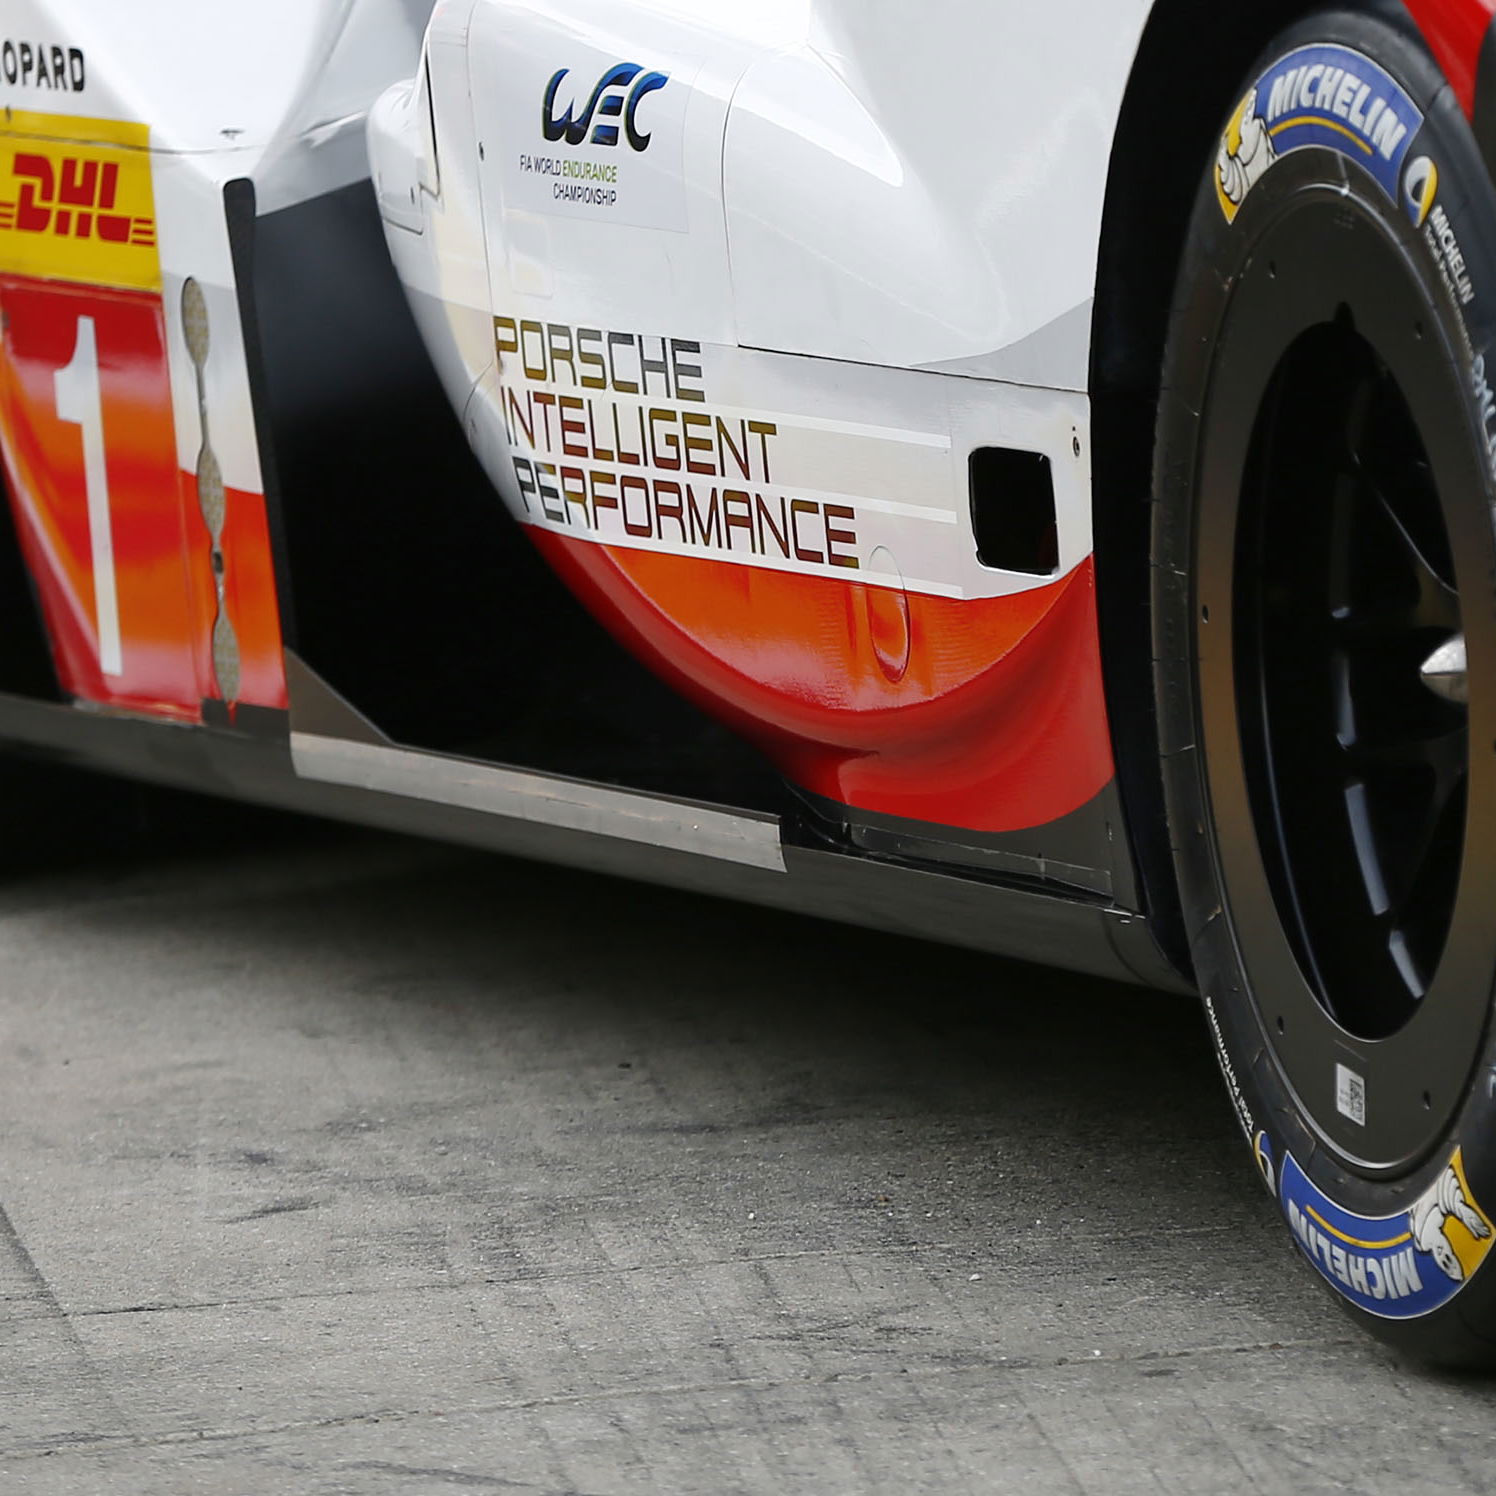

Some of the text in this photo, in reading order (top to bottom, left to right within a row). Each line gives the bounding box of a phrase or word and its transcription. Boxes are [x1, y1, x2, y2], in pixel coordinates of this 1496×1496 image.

[0, 40, 86, 93] OPARD
[542, 62, 671, 152] WEC
[1267, 63, 1407, 161] MICHELIN
[13, 152, 132, 244] DHL
[520, 154, 618, 184] FIA WORLD ENDURANCE
[553, 182, 617, 206] CHAMPIONSHIP
[1430, 204, 1475, 305] MICHELIN
[493, 315, 705, 403] PORSCHE
[500, 385, 777, 484] INTELLIGENT
[53, 315, 123, 677] 1
[512, 455, 860, 570] PERFORMANCE
[1288, 1197, 1424, 1301] MICHELIN
